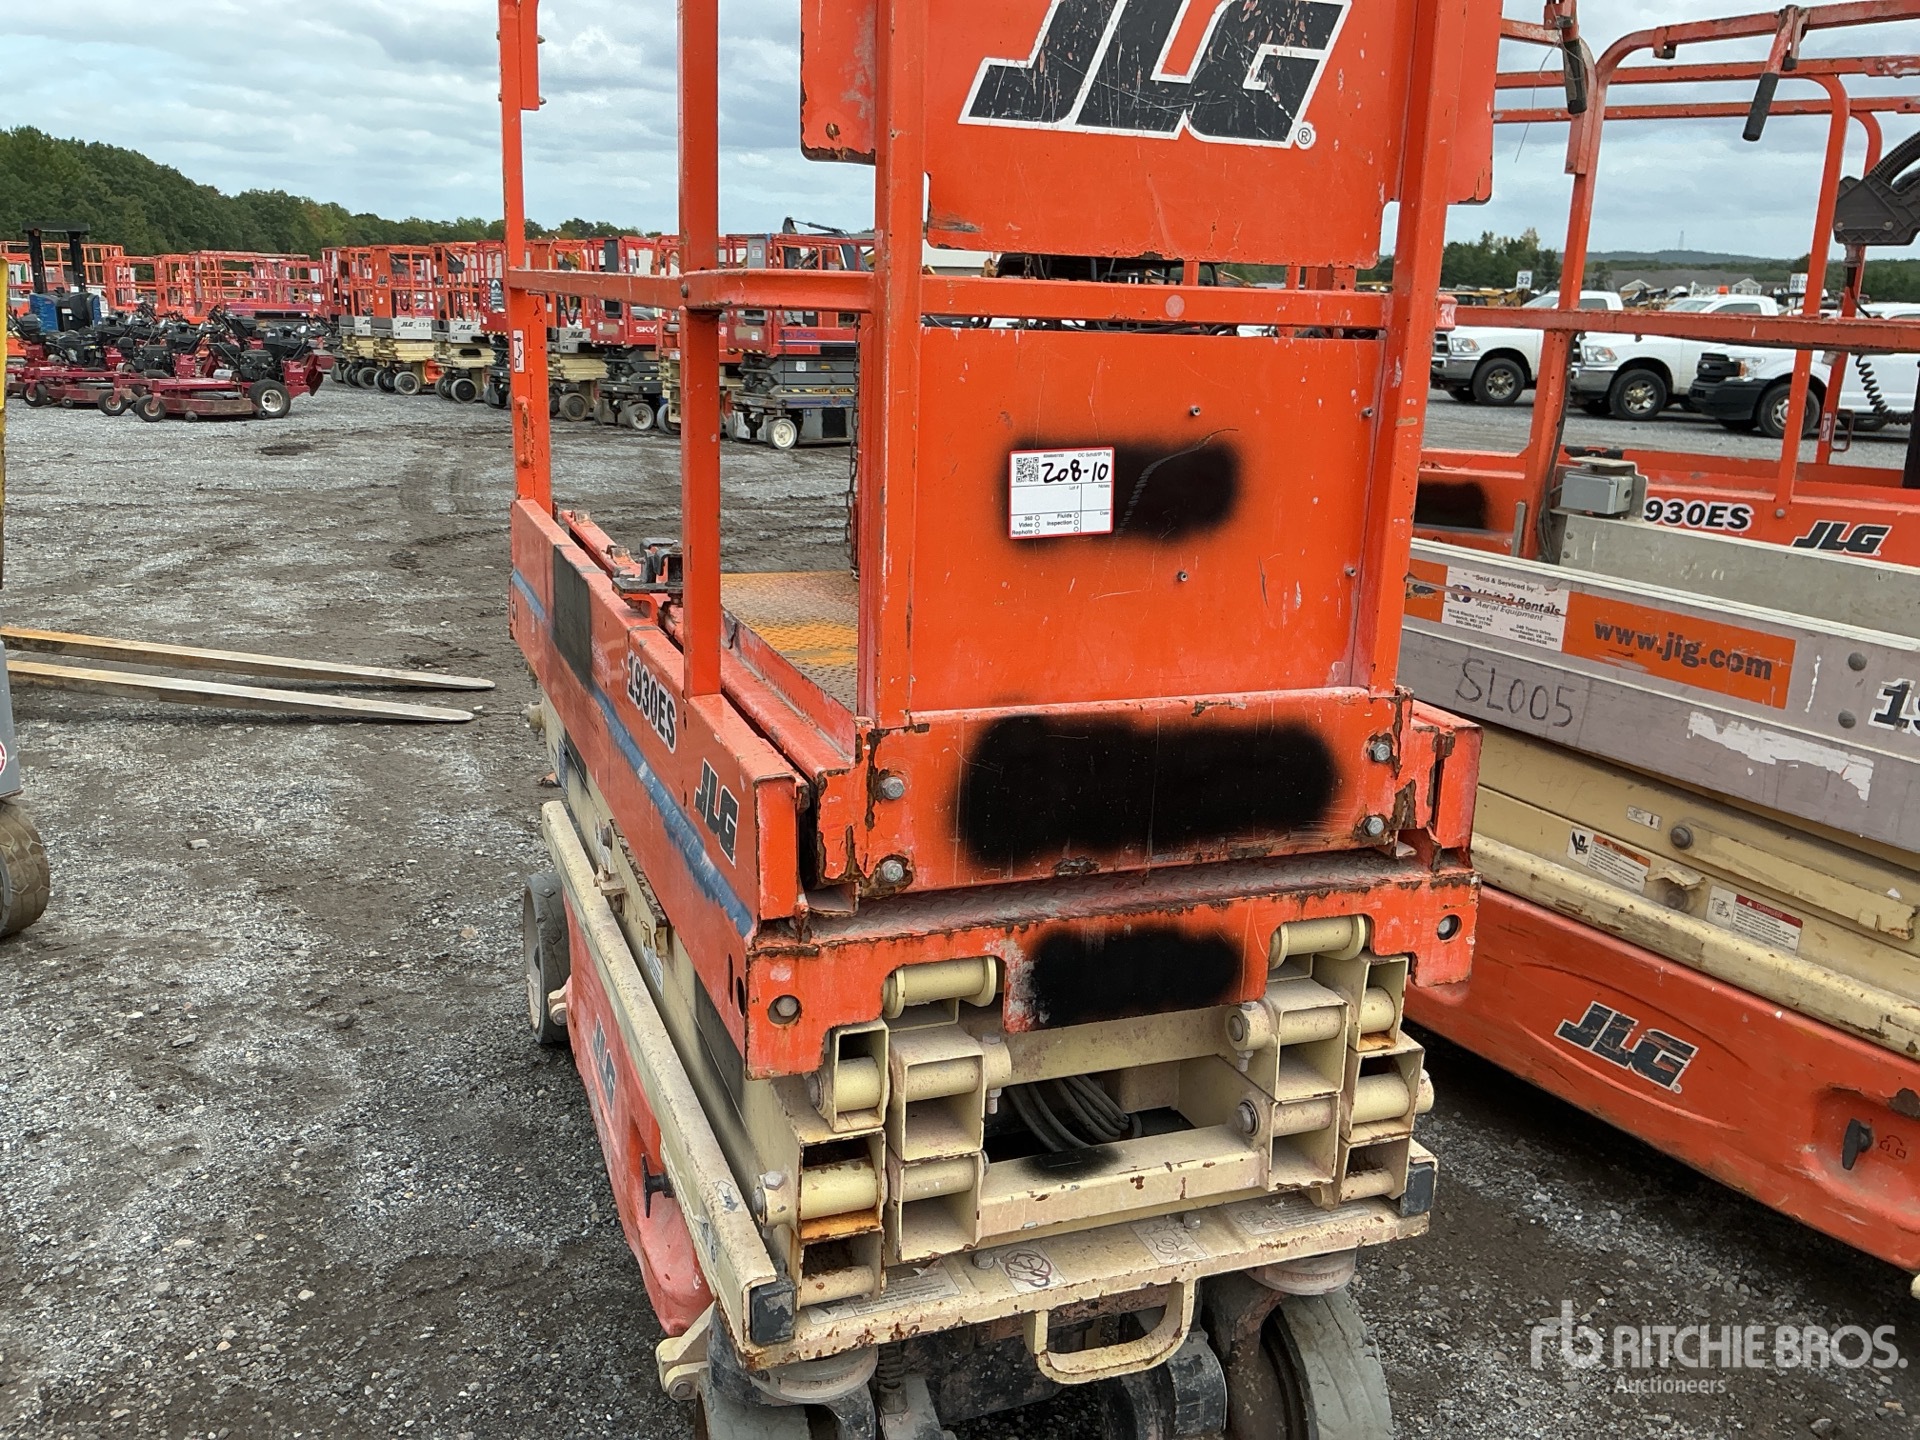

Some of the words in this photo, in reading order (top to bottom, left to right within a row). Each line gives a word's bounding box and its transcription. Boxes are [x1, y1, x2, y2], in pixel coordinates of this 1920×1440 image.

[958, 0, 1352, 150] JLG
[1517, 276, 1530, 285] 32
[1041, 459, 1109, 483] 208-10
[1792, 520, 1893, 556] JLG
[1497, 579, 1525, 590] Serviced
[1526, 585, 1535, 593] by
[1515, 597, 1561, 616] Rentals
[1475, 600, 1499, 611] Aerial
[1500, 605, 1544, 621] Equipment
[1593, 620, 1772, 681] www.jlg.com
[627, 650, 677, 754] 1930ES
[1455, 657, 1576, 728] SL005
[694, 757, 740, 868] JLG
[1554, 1000, 1699, 1091] JLG
